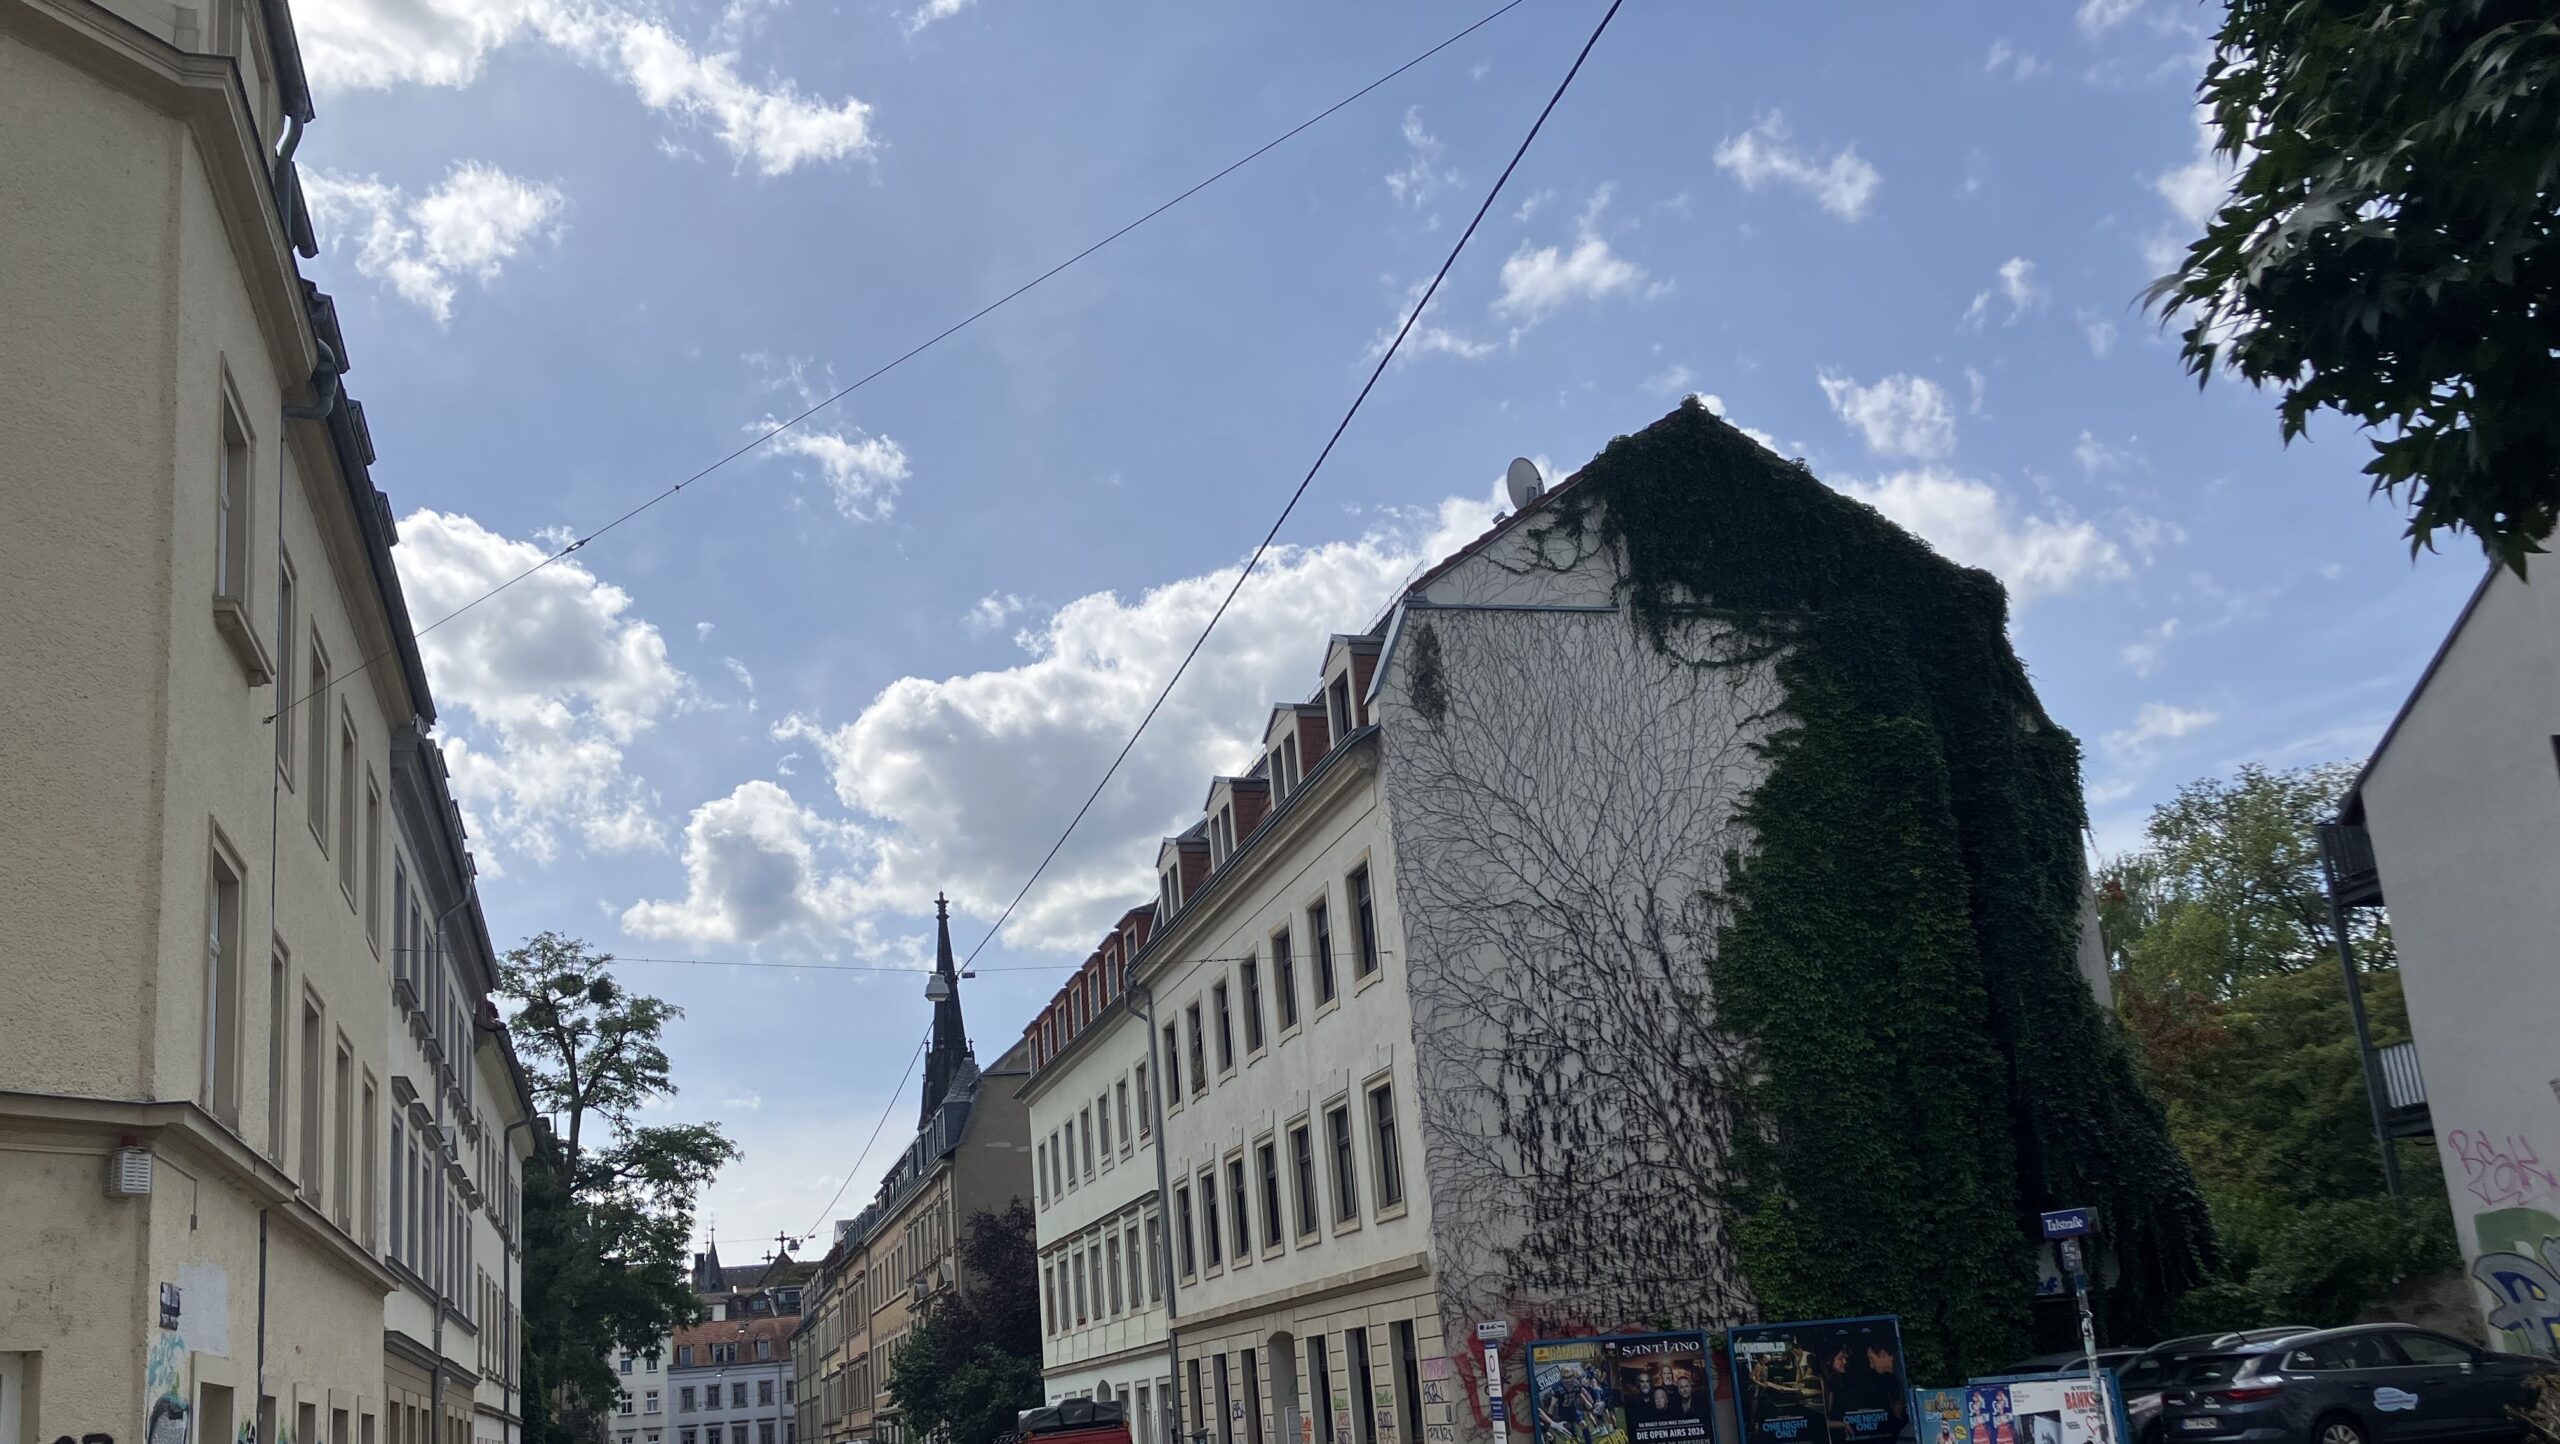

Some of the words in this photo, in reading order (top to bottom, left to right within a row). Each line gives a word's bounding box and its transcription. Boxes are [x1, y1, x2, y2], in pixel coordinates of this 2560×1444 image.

[2045, 1215, 2084, 1232] Talstraße
[1622, 1340, 1700, 1357] SANTIANO
[2064, 1391, 2096, 1410] BANKS
[1843, 1415, 1862, 1425] ONE
[1862, 1412, 1889, 1424] NIGHT
[1762, 1421, 1781, 1432] ONE
[1781, 1419, 1808, 1431] NIGHT
[1856, 1422, 1878, 1432] ONLY
[1636, 1431, 1649, 1440] DIE
[1649, 1429, 1668, 1439] OPEN
[1669, 1428, 1687, 1438] AIRS
[1687, 1426, 1705, 1436] 2026
[1775, 1429, 1797, 1439] ONLY
